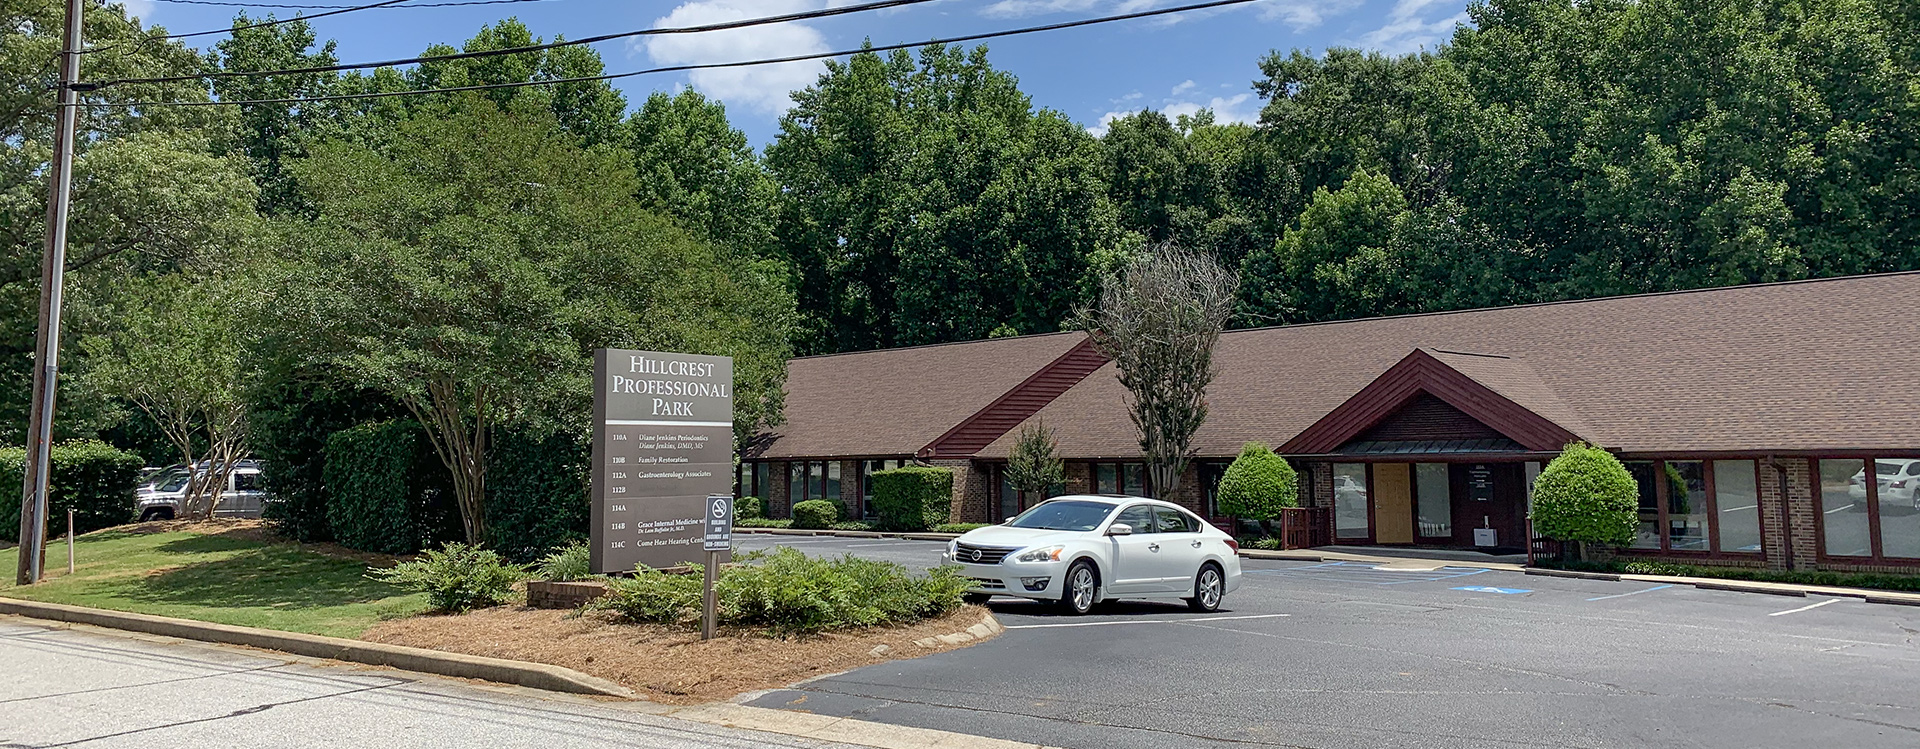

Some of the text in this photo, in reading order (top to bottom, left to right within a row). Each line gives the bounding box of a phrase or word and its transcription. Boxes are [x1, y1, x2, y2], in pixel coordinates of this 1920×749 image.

[630, 356, 714, 378] HILLCREST
[612, 375, 728, 398] PROFESSIONAL
[652, 398, 694, 416] PARK
[638, 457, 657, 465] Family
[638, 471, 684, 479] Gastroenterology
